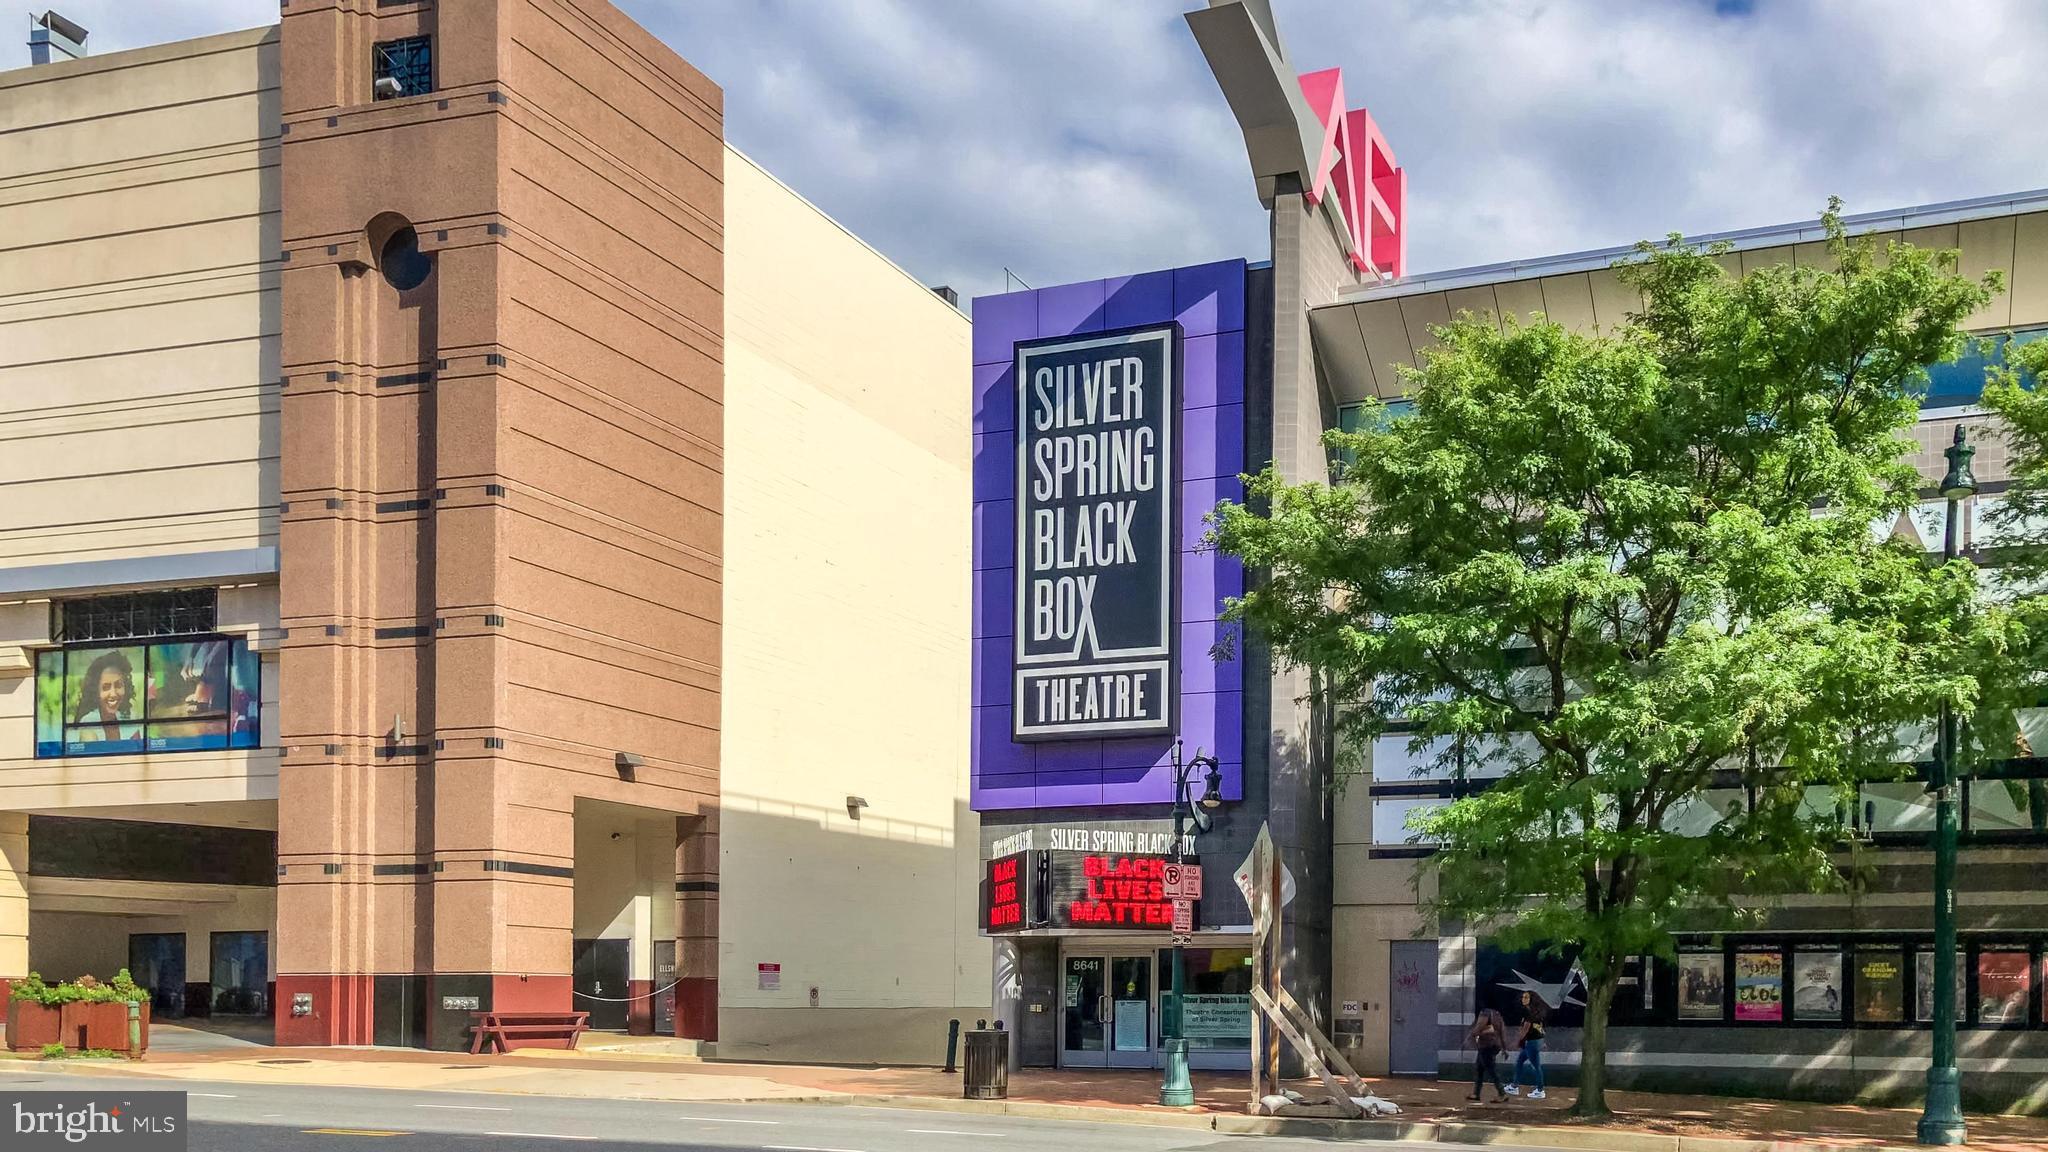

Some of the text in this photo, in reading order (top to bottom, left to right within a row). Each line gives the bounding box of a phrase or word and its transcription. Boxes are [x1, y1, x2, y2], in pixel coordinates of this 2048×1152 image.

[1034, 357, 1143, 431] SILVER
[1034, 426, 1154, 501] SPRING
[1034, 500, 1137, 571] BLACK
[1034, 575, 1099, 657] BOX
[1036, 674, 1147, 722] THEATRE
[1051, 828, 1089, 850] SILVER
[1093, 830, 1133, 853] SPRING
[1138, 833, 1172, 855] BLACK
[1175, 835, 1196, 856] OX
[1083, 856, 1166, 877] BLACK
[1088, 880, 1163, 900] LIVES
[1071, 901, 1173, 923] MATTER
[1073, 960, 1098, 970] 8641
